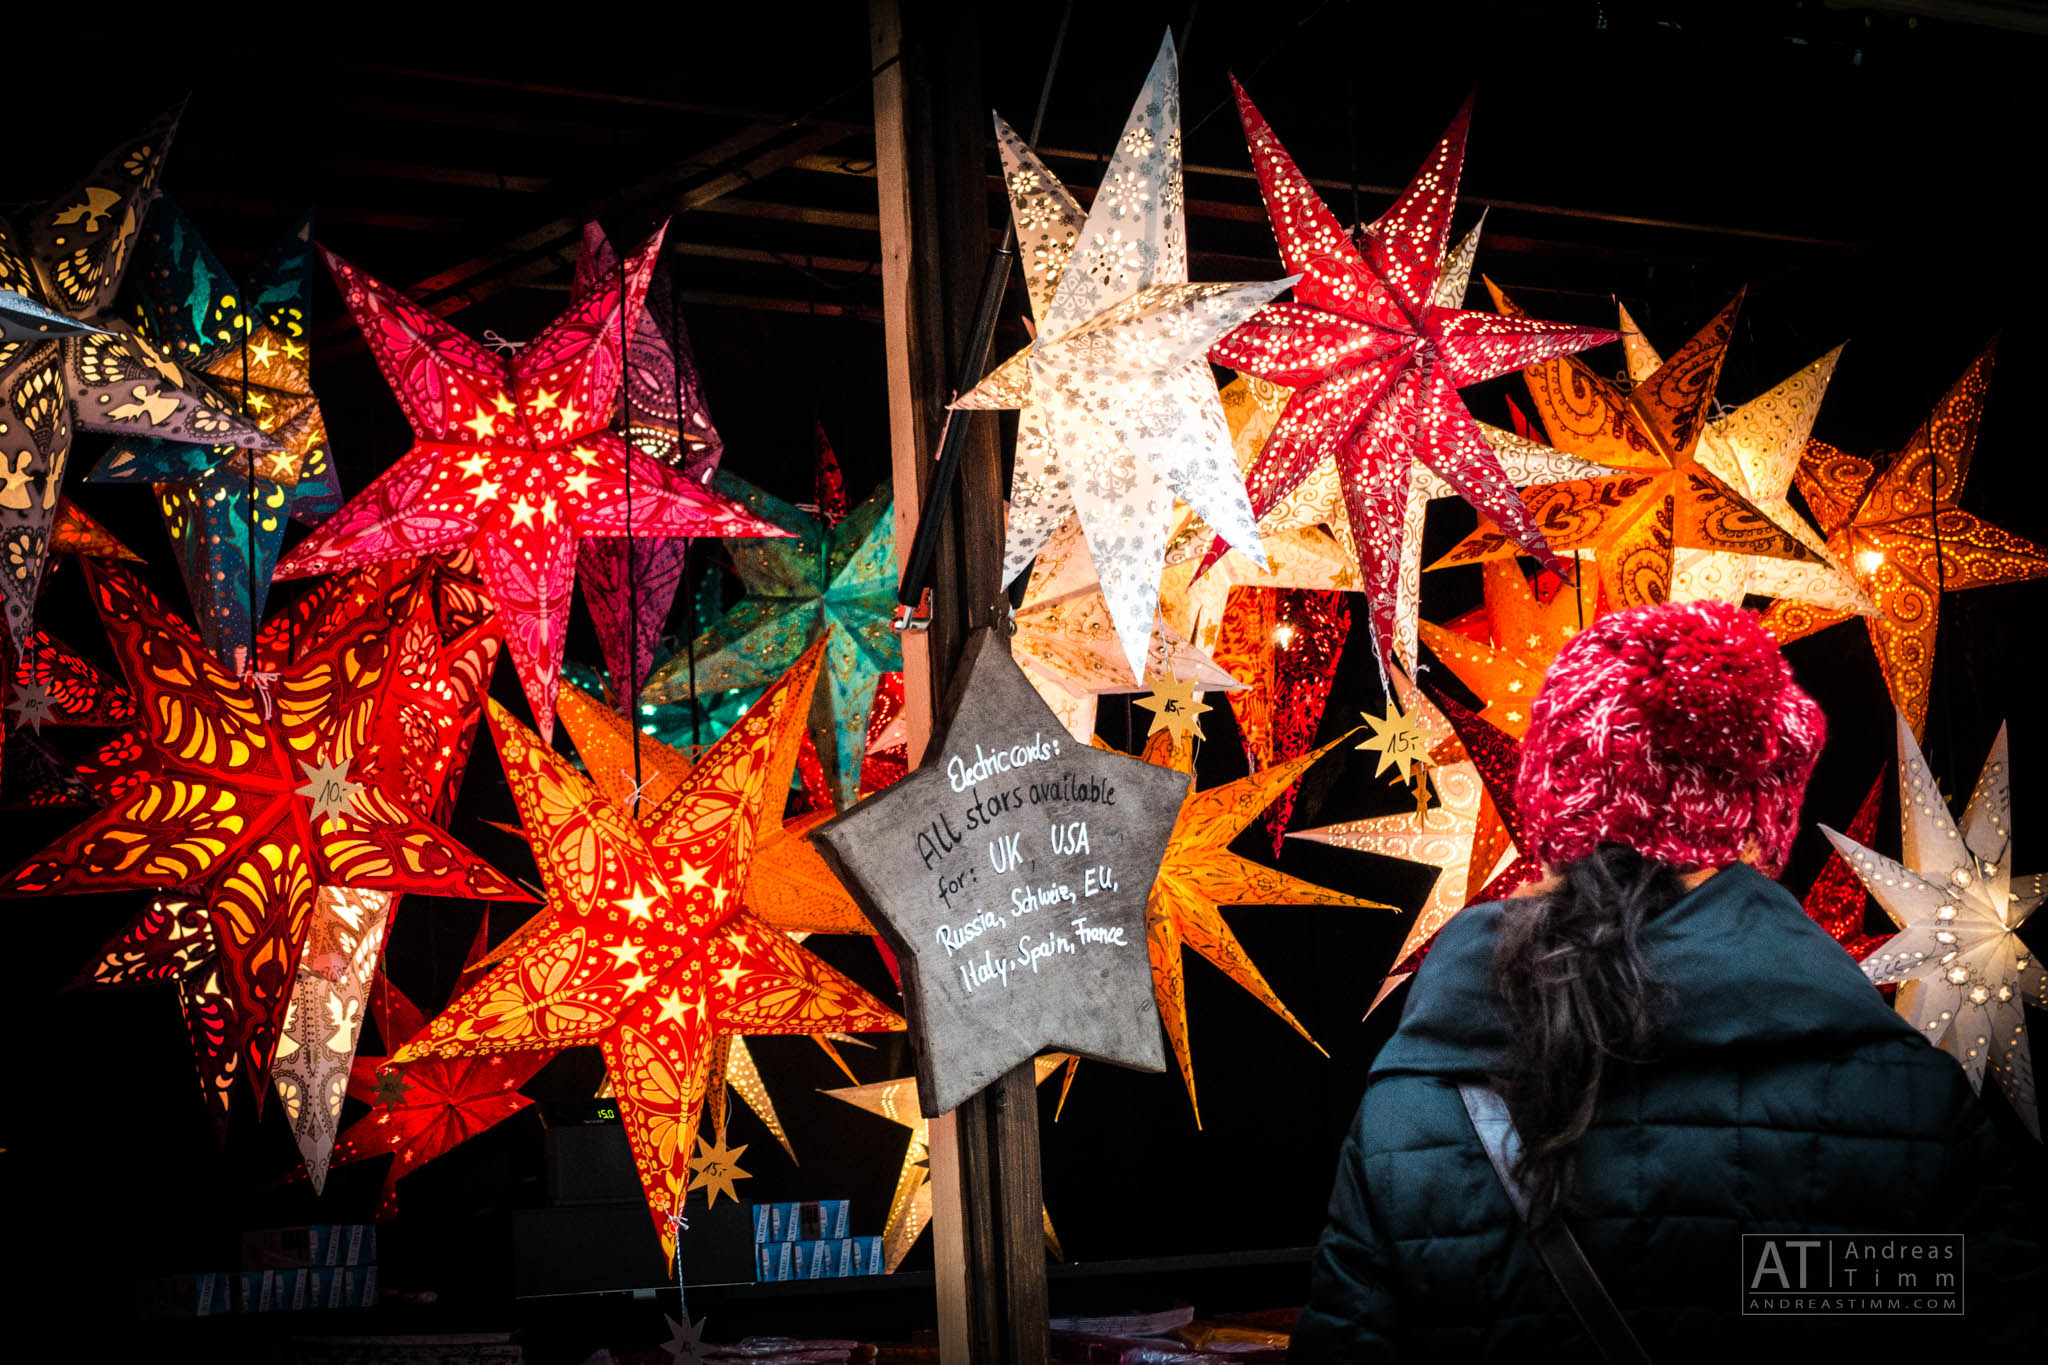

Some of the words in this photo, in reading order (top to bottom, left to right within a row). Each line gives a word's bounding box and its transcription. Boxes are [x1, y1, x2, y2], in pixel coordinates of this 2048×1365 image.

[1010, 732, 1060, 768] cords:
[966, 787, 1024, 831] stars
[1029, 774, 1117, 806] available
[938, 867, 978, 909] for:
[1051, 821, 1090, 856] USA
[936, 908, 1007, 958] Russia,
[1084, 865, 1119, 898] EU,
[960, 949, 1016, 993] Italy,
[1017, 934, 1076, 974] Spain,
[1071, 917, 1128, 947] France
